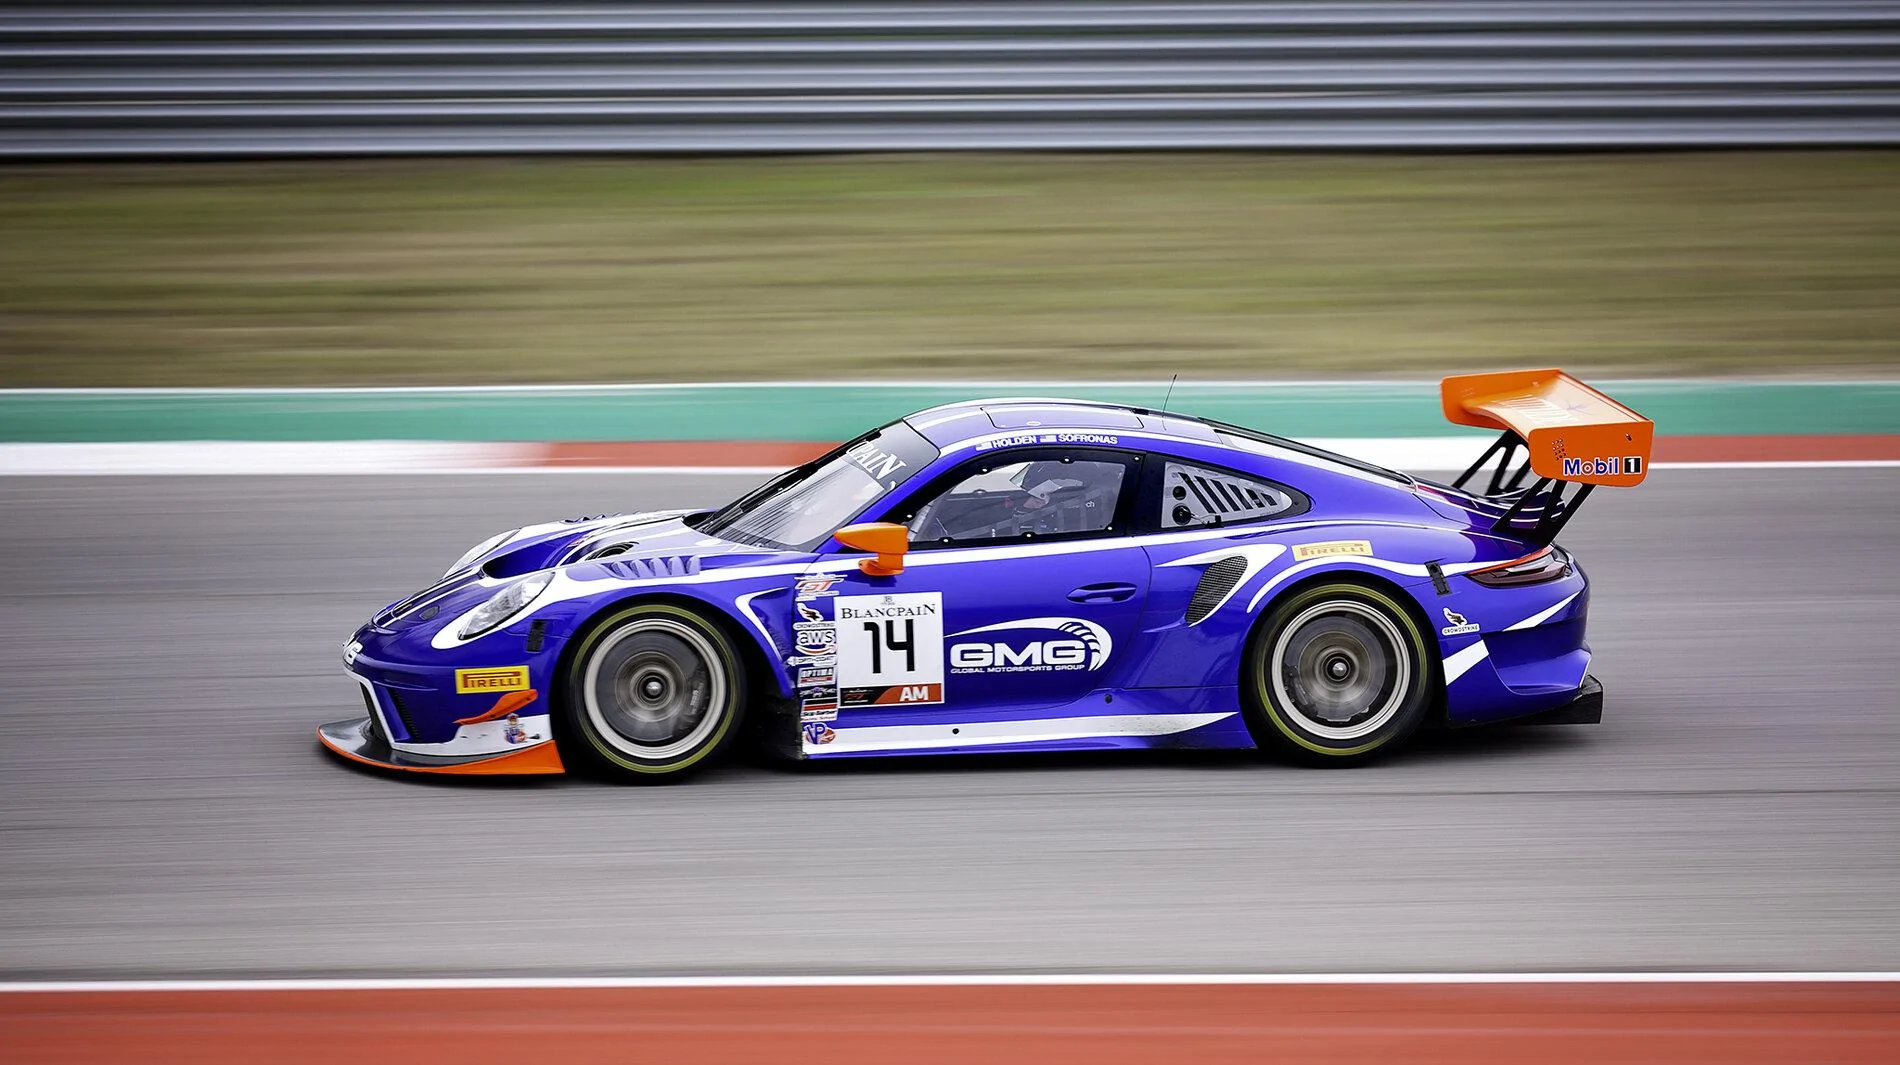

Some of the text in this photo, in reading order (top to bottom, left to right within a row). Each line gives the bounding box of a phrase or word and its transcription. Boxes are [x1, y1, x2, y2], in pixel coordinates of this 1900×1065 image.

[993, 433, 1118, 448] HOLDEN SOFRONAS
[1563, 457, 1640, 476] Mobil 1
[1300, 543, 1365, 556] PIRELLI
[841, 603, 936, 619] BLANCPAIN
[799, 630, 834, 645] aws
[864, 619, 915, 674] 14
[950, 640, 1086, 668] GMG
[987, 665, 1053, 673] MOTORSPORTS
[462, 671, 522, 688] PIRELLI
[899, 685, 929, 702] AM
